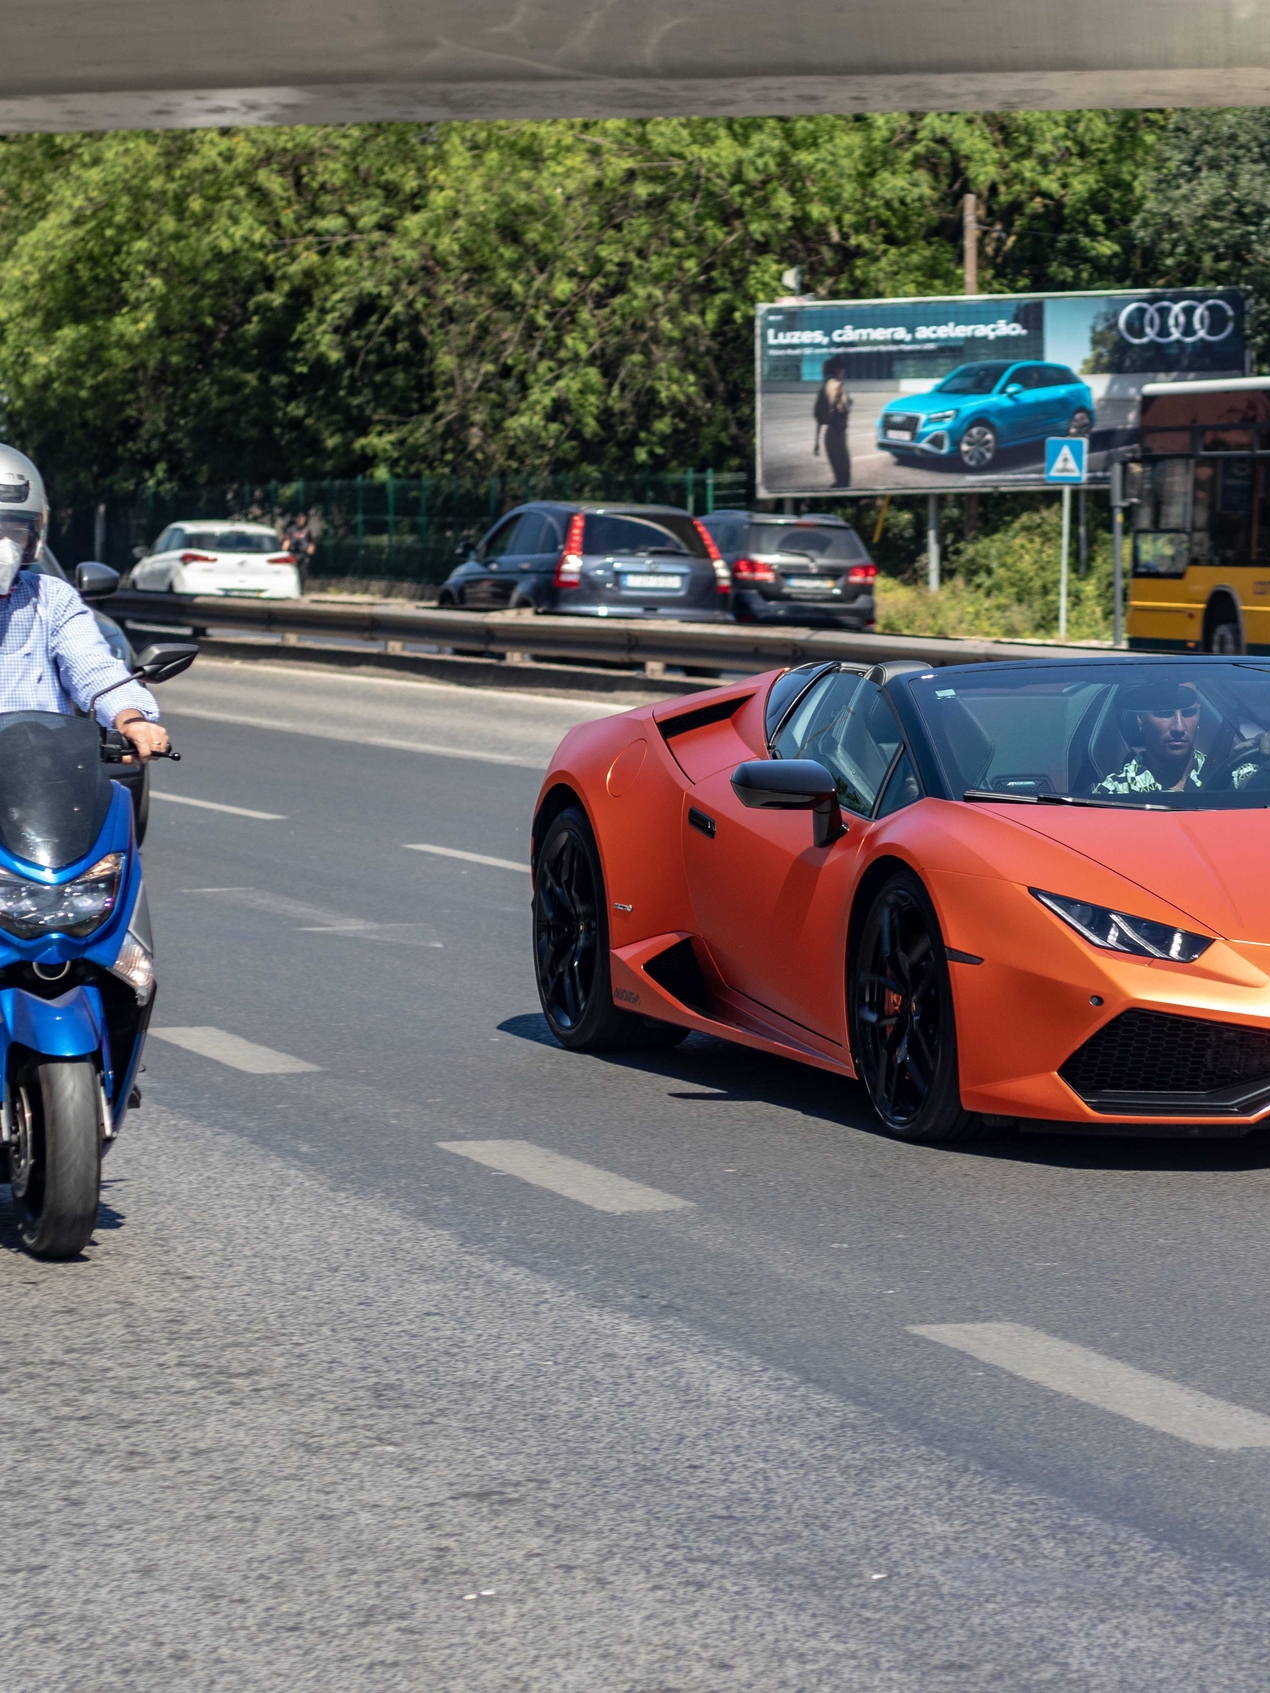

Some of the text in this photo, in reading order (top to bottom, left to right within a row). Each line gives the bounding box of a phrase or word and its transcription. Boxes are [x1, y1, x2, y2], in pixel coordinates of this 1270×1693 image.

[767, 319, 1028, 345] Luzes, câmera, aceleração.
